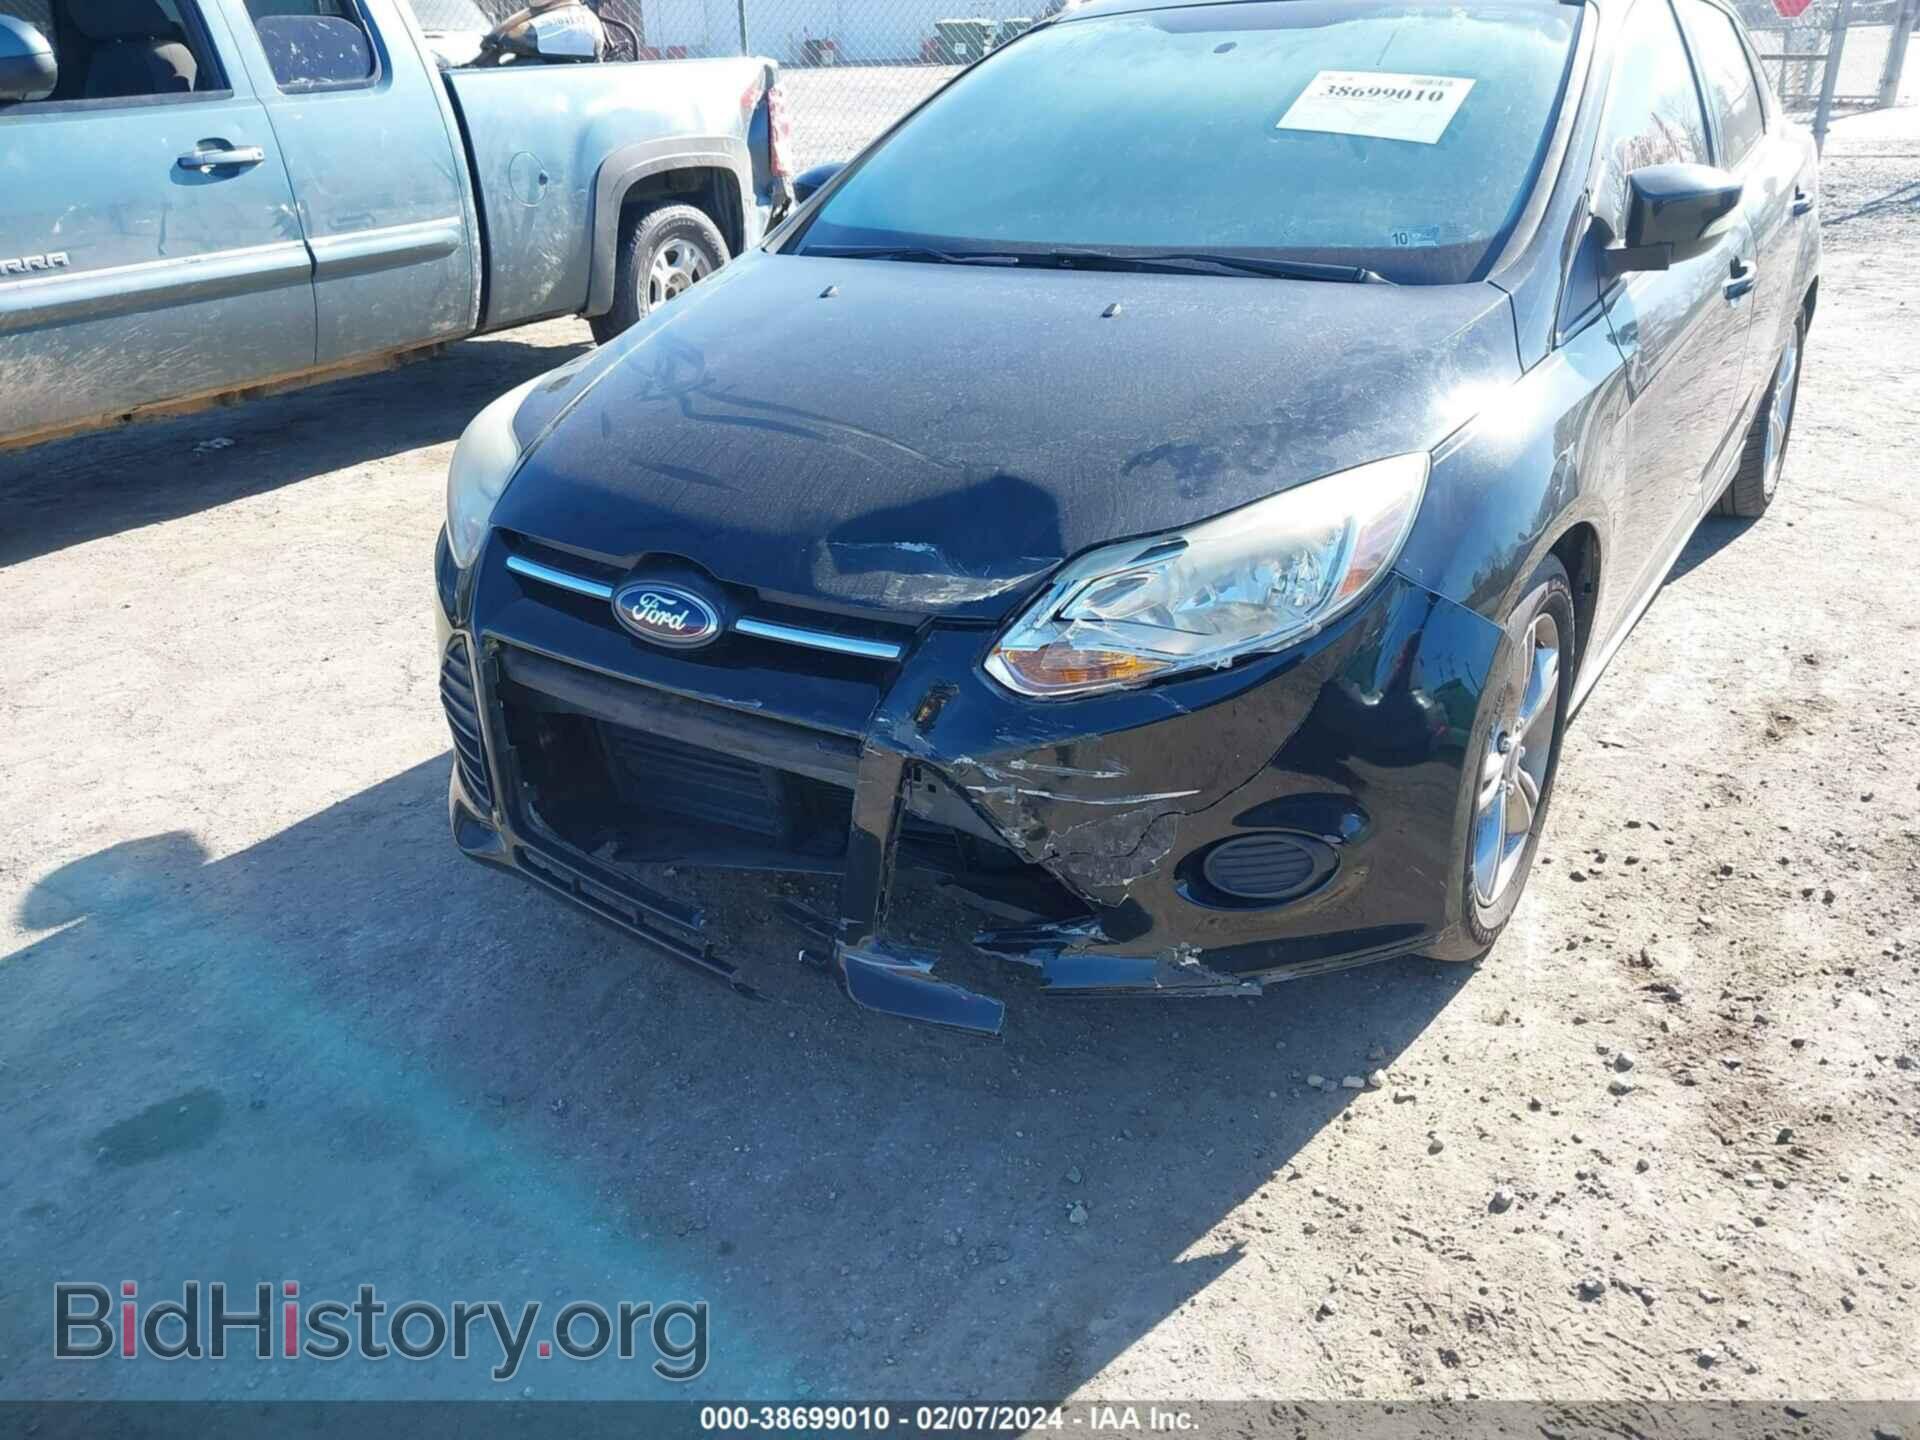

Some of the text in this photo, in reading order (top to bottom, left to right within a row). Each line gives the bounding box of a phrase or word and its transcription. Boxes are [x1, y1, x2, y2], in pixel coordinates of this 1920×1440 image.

[1319, 84, 1445, 102] 38699010
[1391, 232, 1409, 246] 10
[632, 592, 690, 630] Ford
